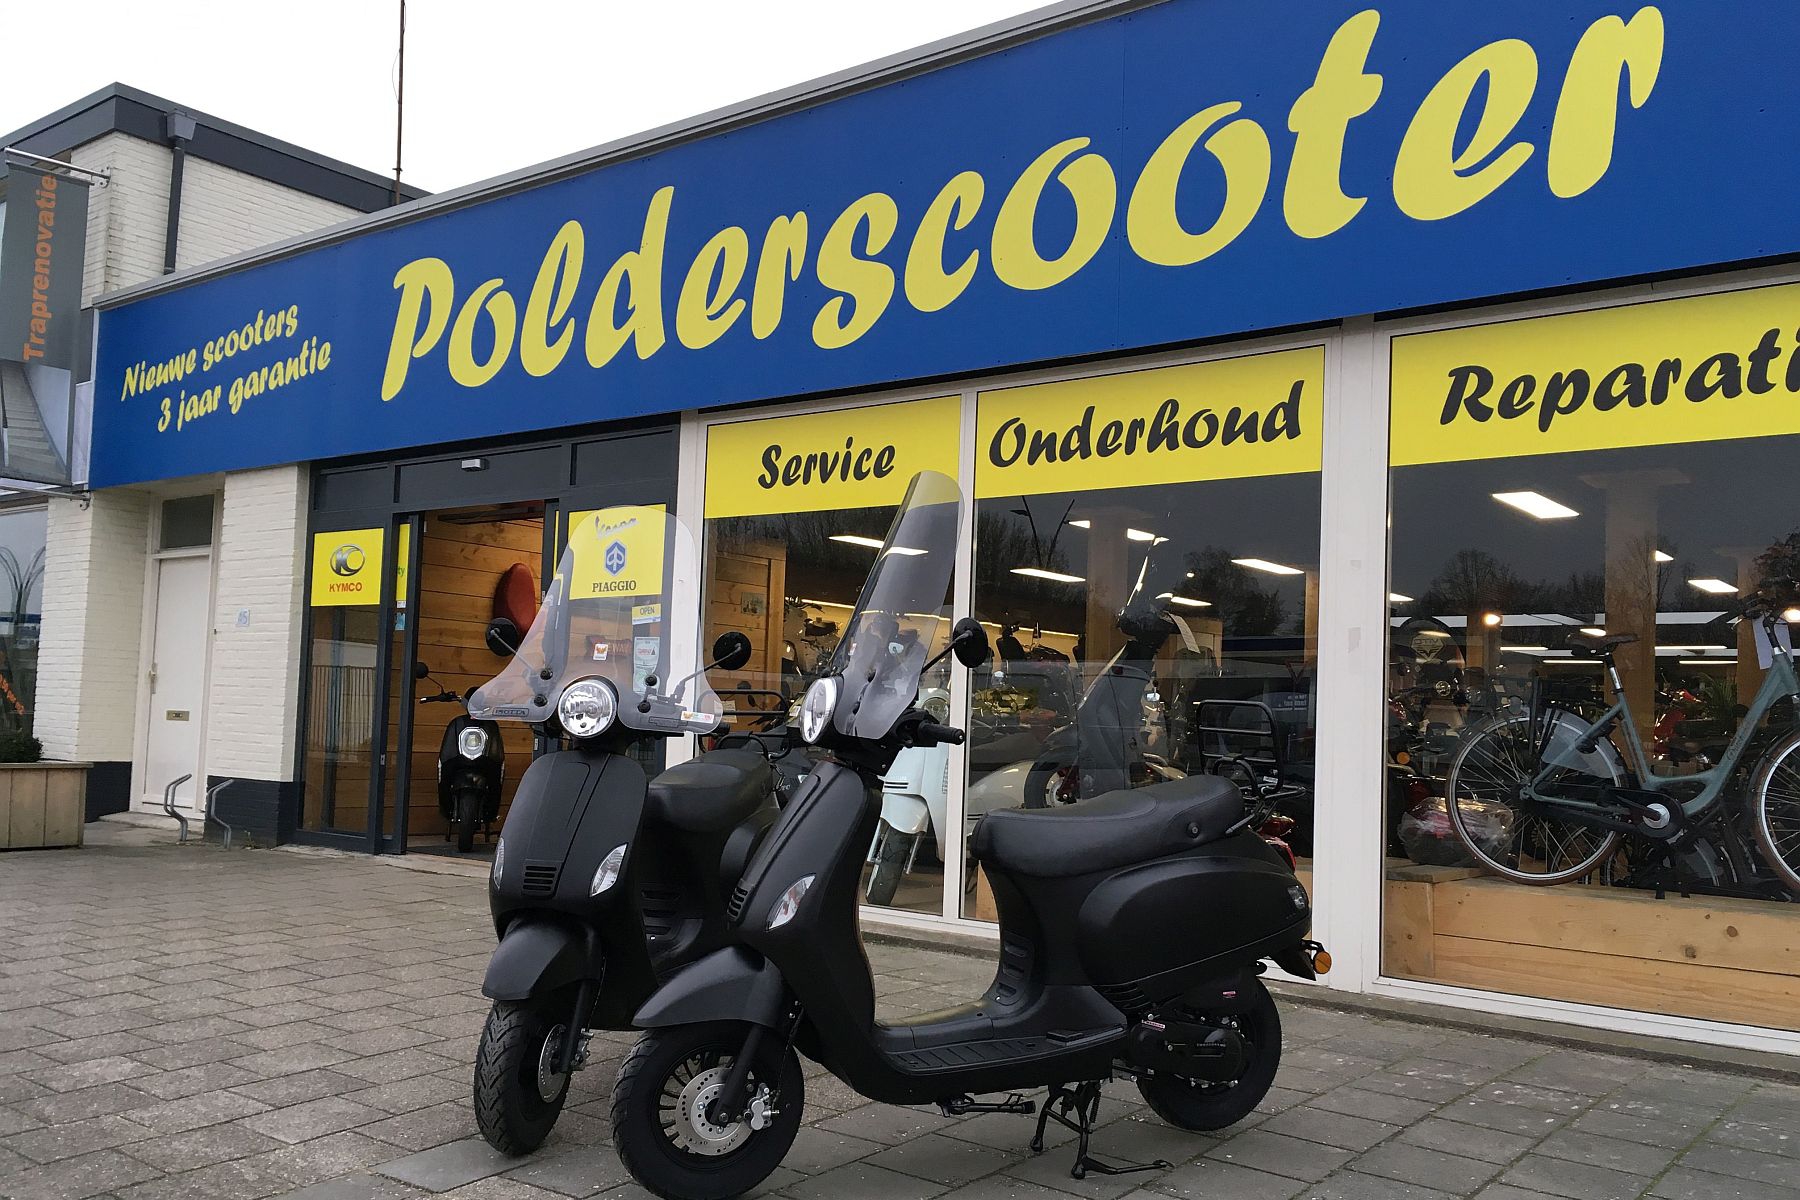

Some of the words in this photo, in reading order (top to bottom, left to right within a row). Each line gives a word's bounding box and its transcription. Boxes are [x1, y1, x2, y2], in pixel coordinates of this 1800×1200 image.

[382, 6, 1664, 401] Polderscooter
[23, 175, 58, 361] Traprenovatie
[120, 348, 197, 402] Nieuwe
[202, 304, 299, 372] scooters
[157, 397, 172, 433] 3
[177, 389, 222, 432] jaar
[228, 335, 332, 415] garantie
[1439, 327, 1800, 433] Reparati
[757, 436, 896, 490] Service
[988, 379, 1305, 468] Onderhoud
[328, 582, 363, 593] KYMCO
[591, 579, 637, 593] PIAGGIO
[639, 606, 655, 616] OPEN
